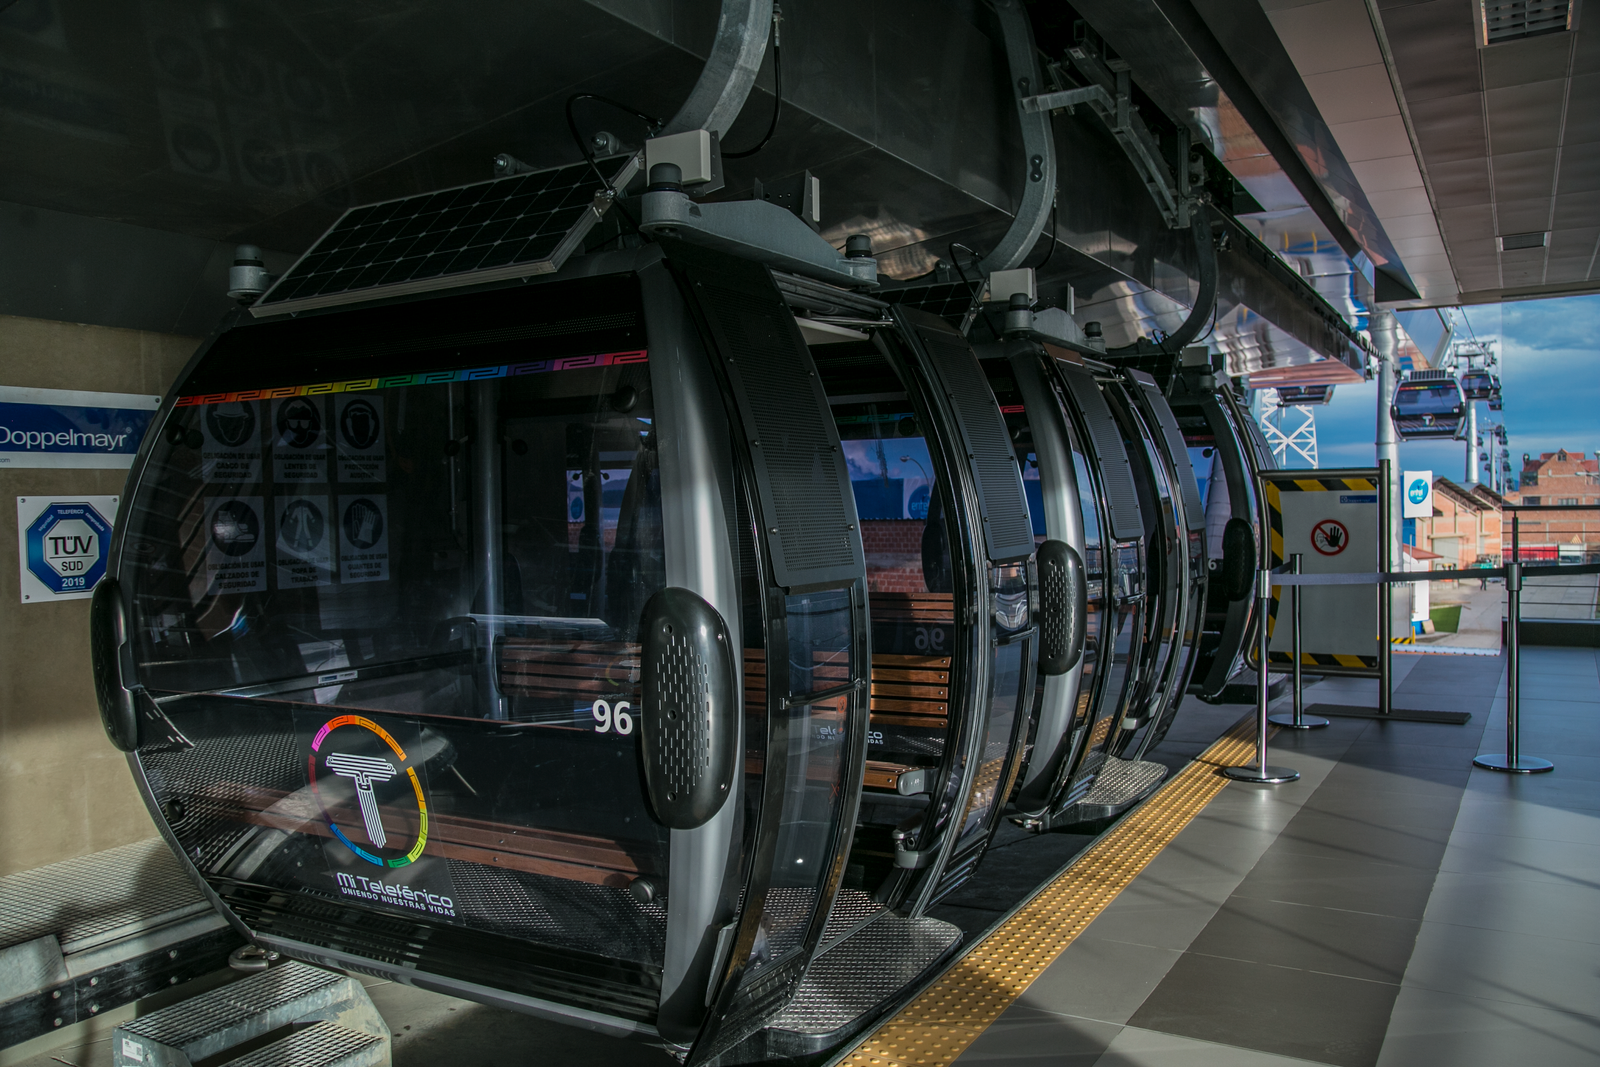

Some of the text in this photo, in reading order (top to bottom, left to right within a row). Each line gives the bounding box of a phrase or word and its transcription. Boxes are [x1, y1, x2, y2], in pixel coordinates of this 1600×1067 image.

[216, 462, 250, 470] CASCO DE
[214, 471, 252, 479] SEGURIDAD
[48, 535, 93, 555] TÜV
[61, 560, 84, 572] SÜD
[250, 560, 265, 568] USAR
[215, 571, 250, 580] CALZADOS
[349, 570, 381, 579] SEGURIDAD
[62, 577, 85, 587] 2019
[218, 580, 256, 589] SEGURIDAD
[592, 699, 633, 735] 96
[336, 872, 454, 908] Mi Teleférico
[340, 887, 456, 917] UNIENDO NUESTRAS VIDAS
